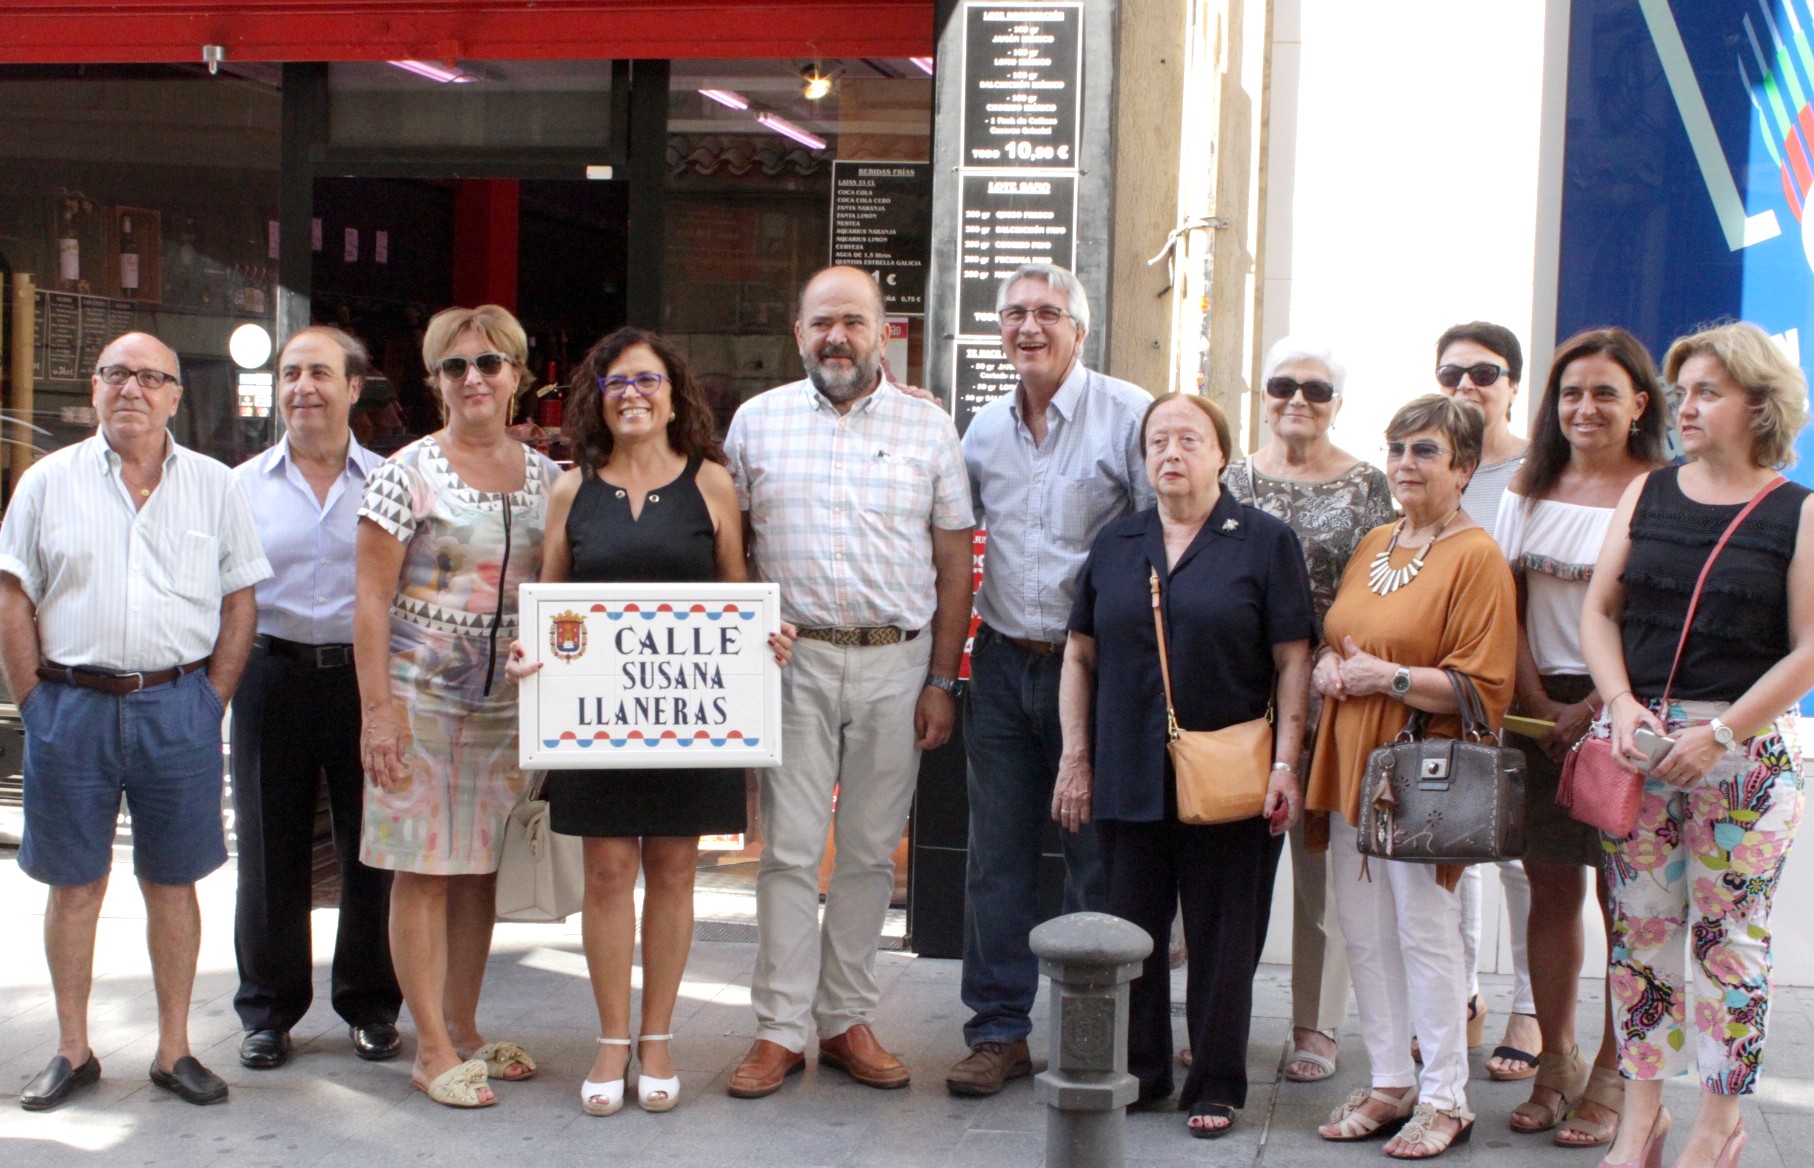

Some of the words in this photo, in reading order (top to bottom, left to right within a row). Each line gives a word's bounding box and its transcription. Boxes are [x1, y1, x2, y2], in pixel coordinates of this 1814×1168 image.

[859, 168, 892, 177] BEBIDAS
[893, 167, 914, 177] FRÍAS
[886, 273, 897, 286] €
[613, 624, 743, 657] CALLE
[621, 660, 726, 691] SUSANA
[577, 695, 729, 727] LLANERAS
